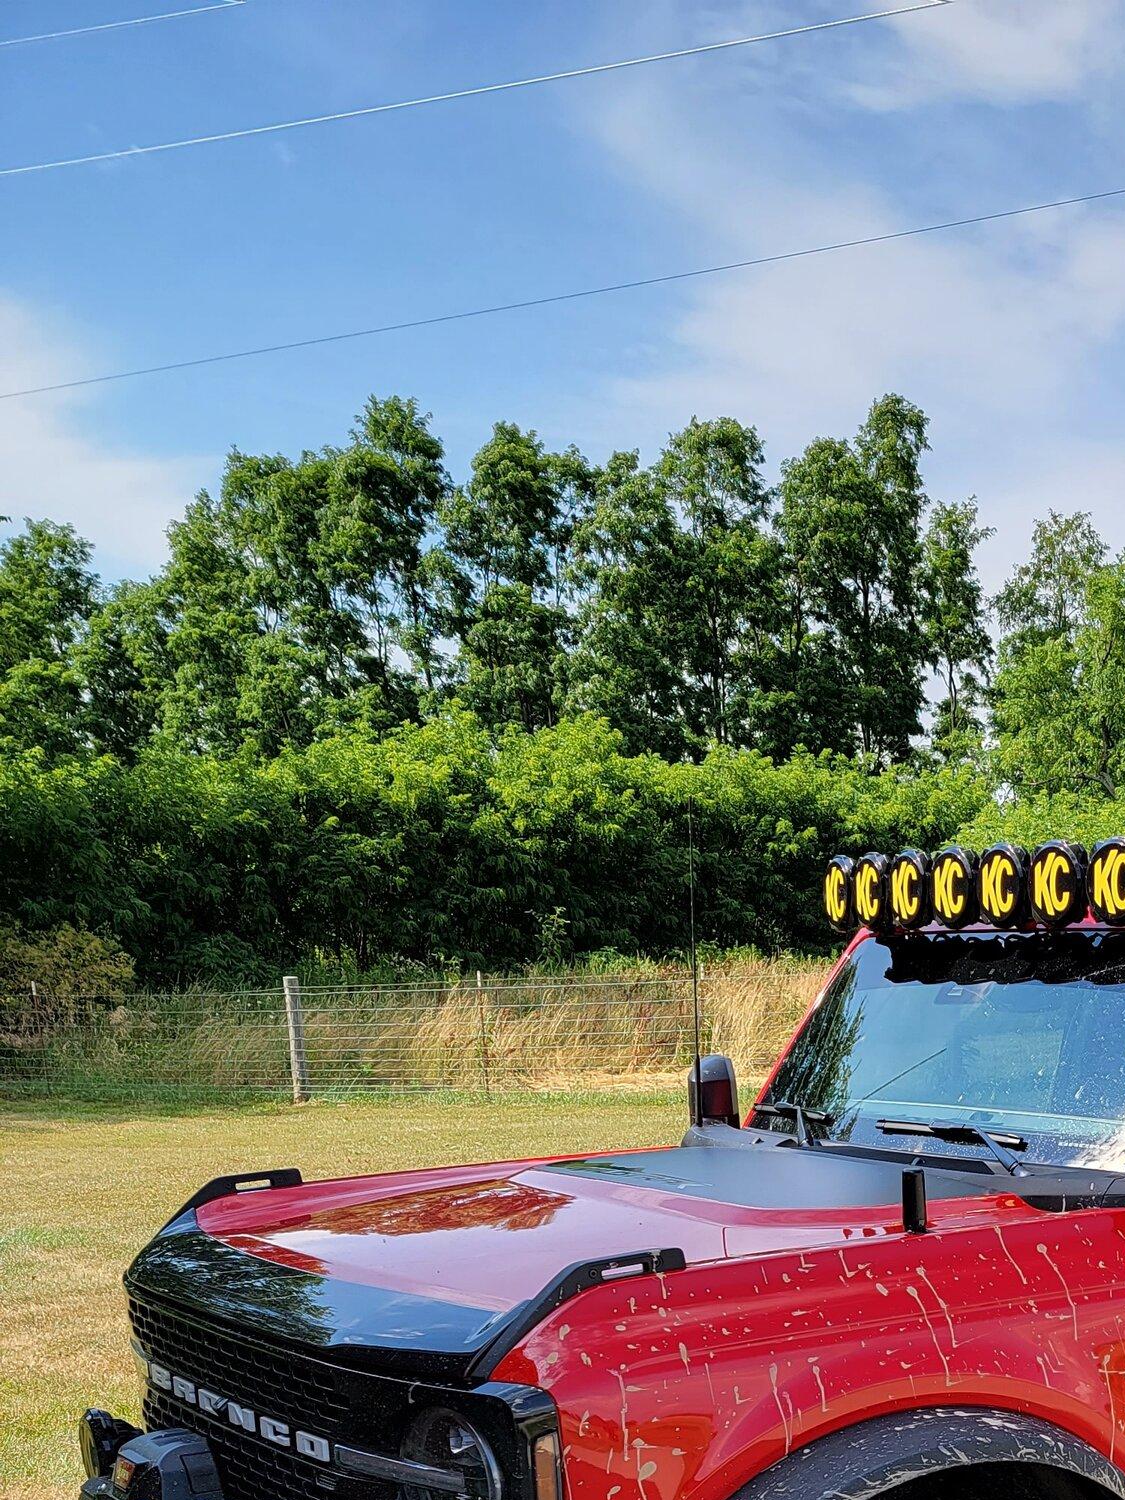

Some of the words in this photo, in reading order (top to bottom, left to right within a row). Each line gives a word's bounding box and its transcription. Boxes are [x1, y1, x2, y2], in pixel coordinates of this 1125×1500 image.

[825, 866, 844, 922] KC
[856, 863, 878, 920] KC
[892, 861, 918, 920] KC
[934, 858, 963, 918] KC
[982, 855, 1013, 918] KC
[1034, 852, 1070, 916] KC
[150, 1363, 330, 1462] BRONCO
